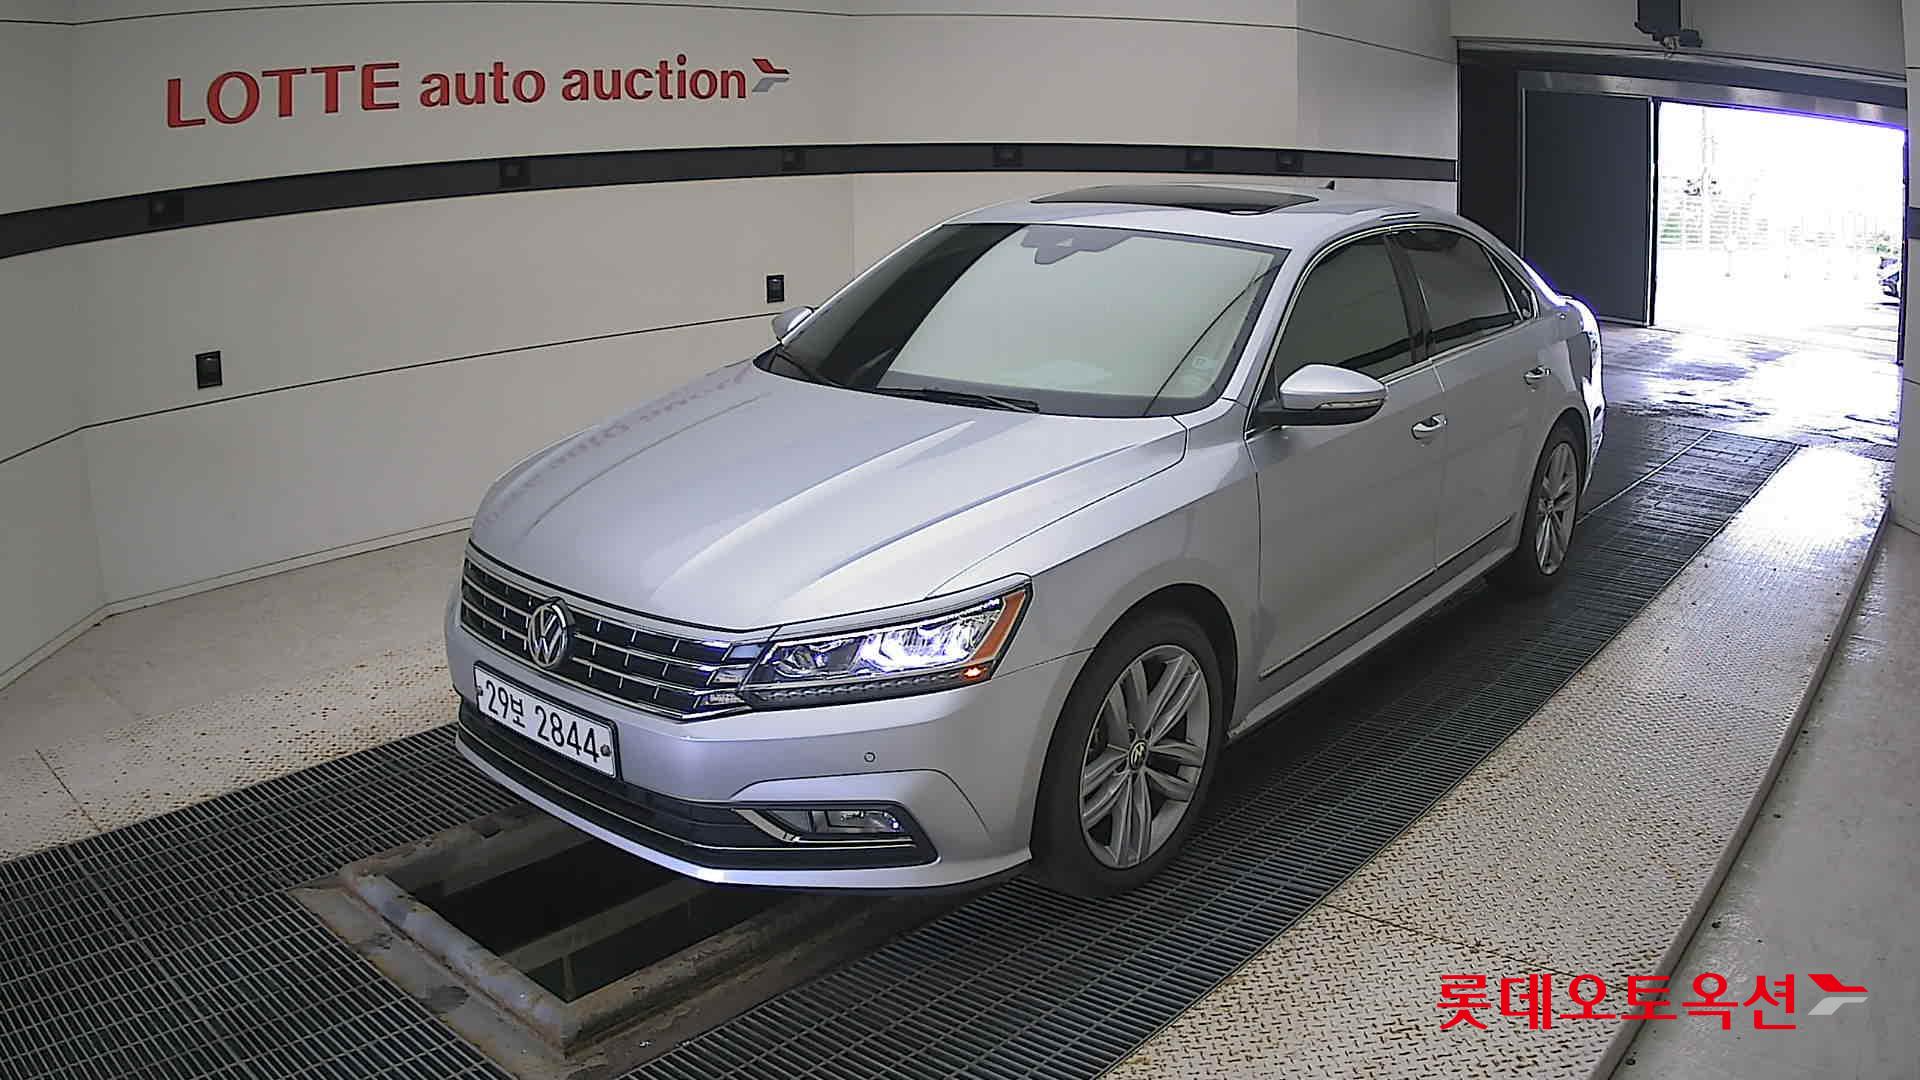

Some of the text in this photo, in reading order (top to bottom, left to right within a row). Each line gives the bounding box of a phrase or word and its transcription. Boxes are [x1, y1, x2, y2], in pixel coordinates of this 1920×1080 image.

[167, 54, 747, 128] LOTTE auto auction
[486, 679, 600, 763] 29보 2844
